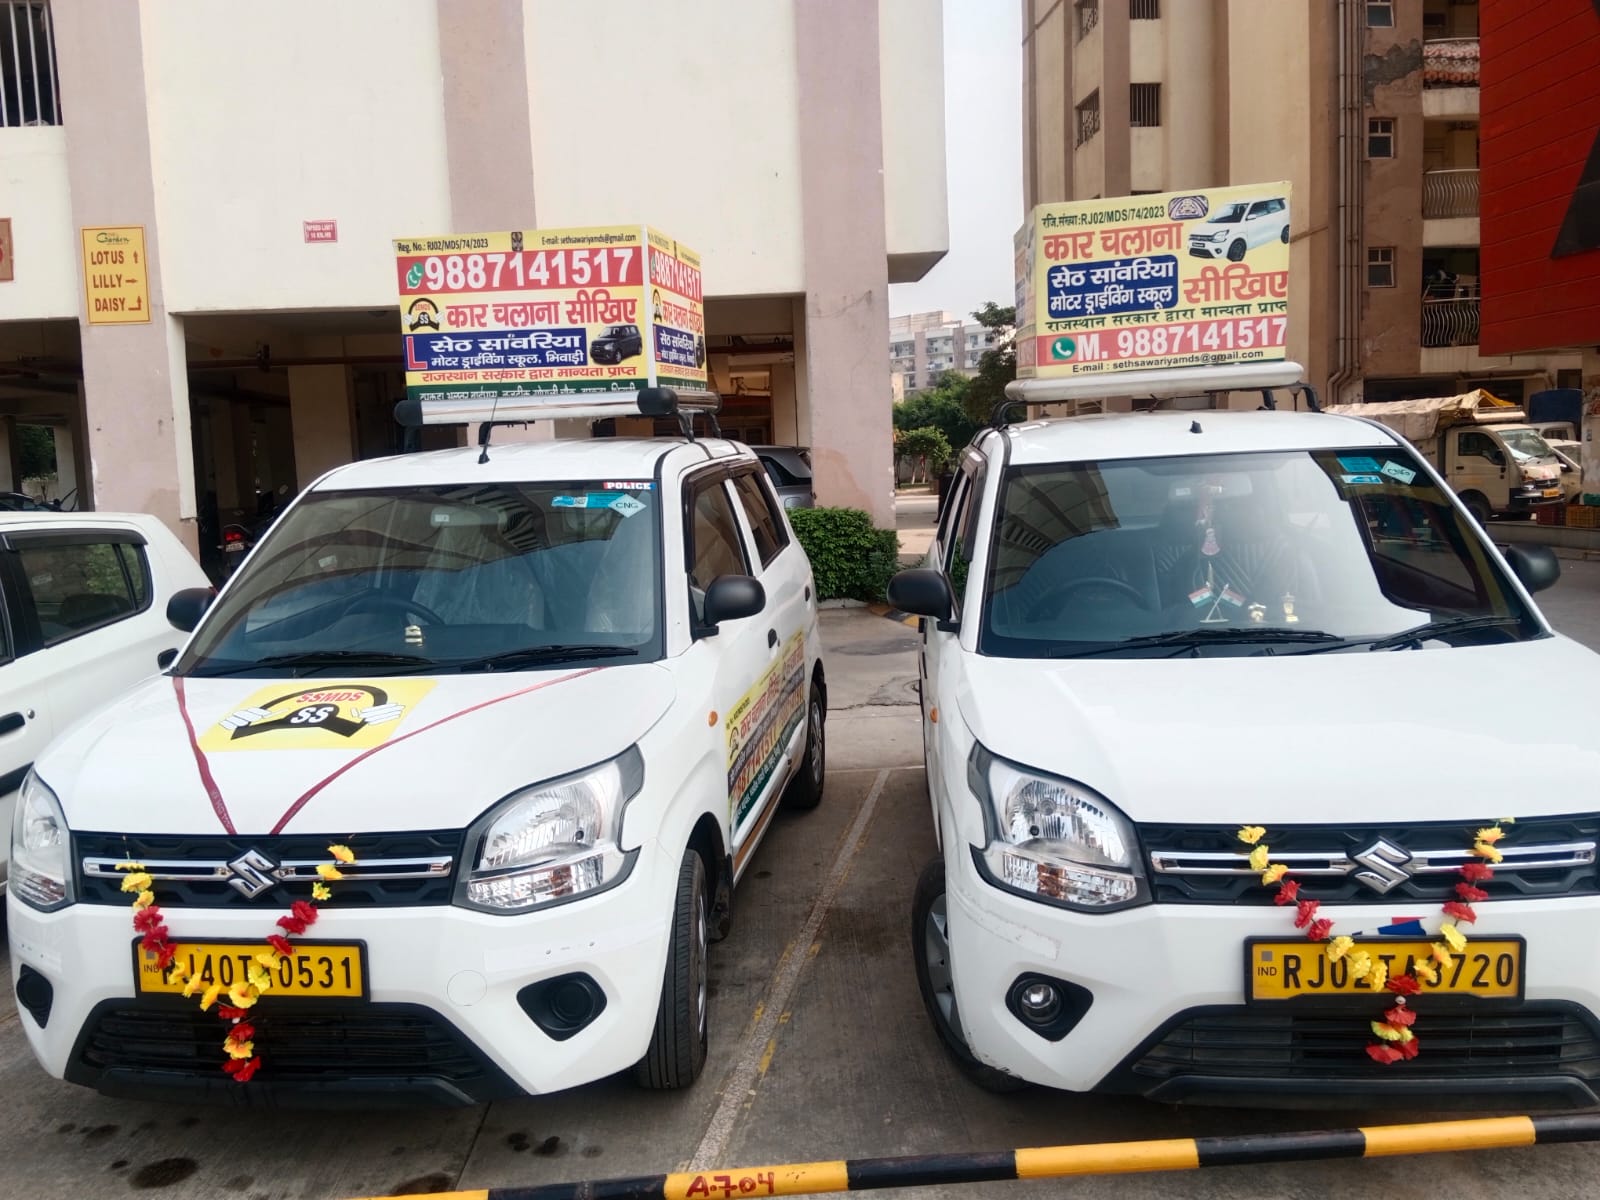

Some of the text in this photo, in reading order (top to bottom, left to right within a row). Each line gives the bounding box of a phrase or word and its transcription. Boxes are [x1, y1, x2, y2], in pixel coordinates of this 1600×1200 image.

[397, 242, 410, 253] Reg.
[427, 238, 488, 252] RJ02/MDS/74/2023
[1043, 223, 1184, 261] कार चलाना
[91, 250, 125, 265] LOTUS
[424, 248, 633, 291] 9887141517
[1051, 258, 1175, 289] सेठ सांवरिया
[92, 274, 122, 288] LILLY
[1182, 263, 1288, 304] सीखिए
[95, 297, 125, 312] DAISY
[1051, 284, 1173, 314] मोटर ड्राईविंग स्कूल
[446, 289, 637, 328] कार चलाना सीखिए
[420, 313, 429, 324] SS
[1046, 316, 1106, 332] राजस्थान
[1112, 312, 1160, 326] सरकार
[1165, 308, 1195, 323] द्वारा
[1201, 304, 1252, 318] मान्यता
[430, 336, 473, 352] सेठ
[1078, 317, 1287, 361] M. 9887141517
[406, 336, 428, 370] L
[431, 355, 459, 366] मोटर
[545, 350, 584, 365] भिवाड़ी
[1112, 350, 1264, 370] sethsawariyamds@gmail.com
[421, 366, 637, 382] राजस्थान सरकार द्वारा मान्यता प्राप्त
[607, 482, 651, 490] POLICE
[296, 692, 364, 703] SSMDS
[290, 706, 334, 724] SS
[144, 964, 159, 974] IND
[1257, 967, 1277, 977] IND
